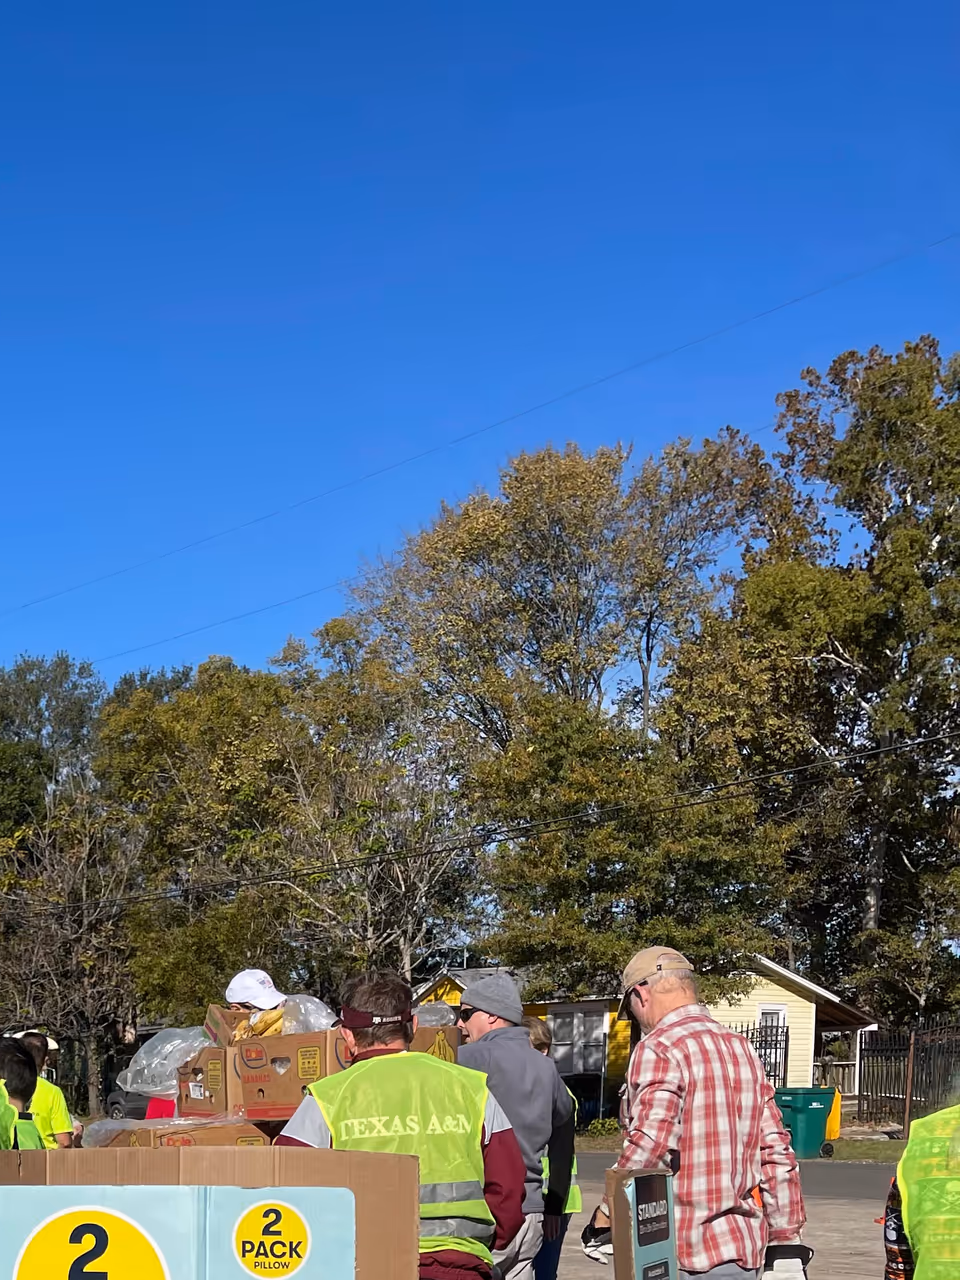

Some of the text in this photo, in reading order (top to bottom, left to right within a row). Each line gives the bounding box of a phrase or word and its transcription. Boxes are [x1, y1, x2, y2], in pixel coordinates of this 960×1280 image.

[340, 1115, 420, 1141] TEXAS
[638, 1200, 667, 1221] STANDARD
[262, 1208, 282, 1236] 2
[241, 1240, 303, 1259] PACK
[254, 1261, 290, 1270] PILLOW
